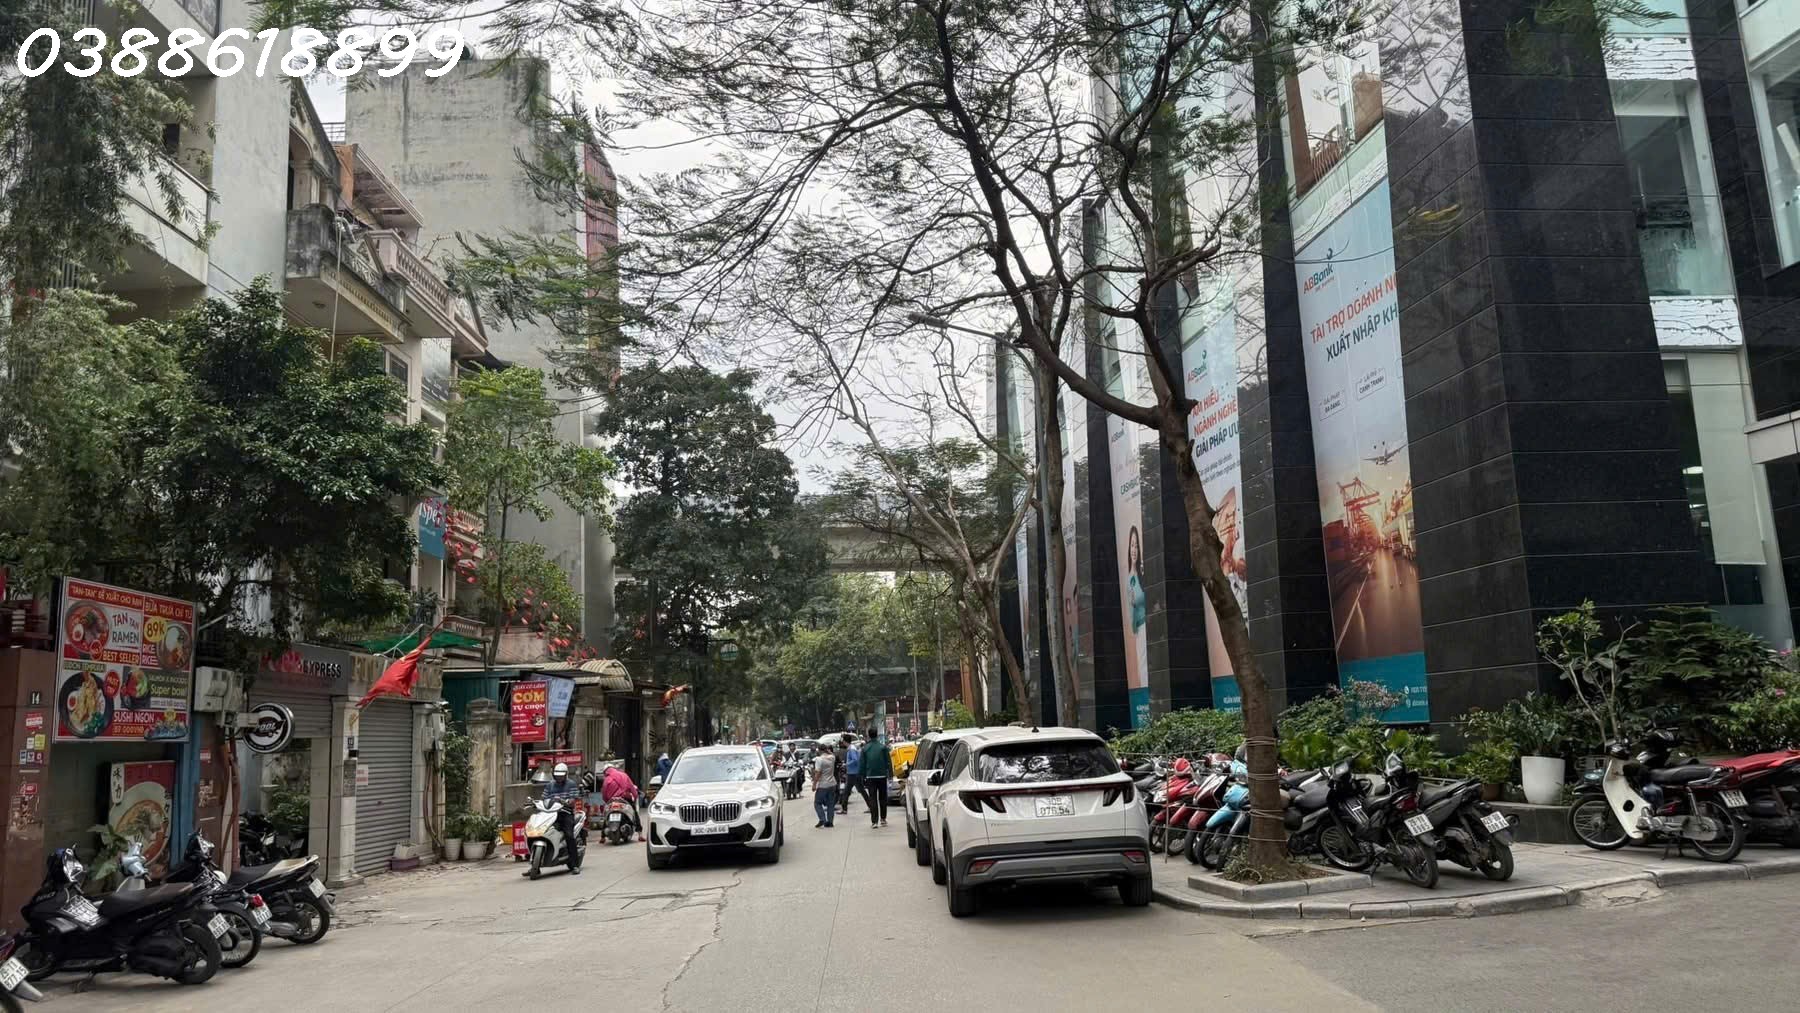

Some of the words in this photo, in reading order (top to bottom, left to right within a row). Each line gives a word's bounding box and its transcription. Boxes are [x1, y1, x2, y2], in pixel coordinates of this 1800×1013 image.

[1310, 323, 1326, 344] TÀI
[1326, 308, 1346, 333] TRỢ
[1326, 330, 1351, 362] XUẤT
[1352, 314, 1381, 345] NHẬP
[1383, 302, 1399, 326] KH
[1194, 412, 1217, 437] NGÀNH
[1195, 437, 1209, 458] GIẢI
[1210, 427, 1228, 450] PHÁP
[112, 612, 129, 627] TAN
[129, 617, 139, 630] TAN
[112, 631, 139, 643] RAMEN
[103, 650, 118, 662] BEST
[119, 652, 140, 665] SELLER
[303, 659, 342, 678] EXPRESS
[150, 684, 170, 697] Super
[513, 690, 545, 704] CƠM
[32, 692, 40, 705] 14
[524, 703, 546, 711] CHỌN
[113, 712, 134, 723] SUSHI
[134, 713, 155, 723] NGON
